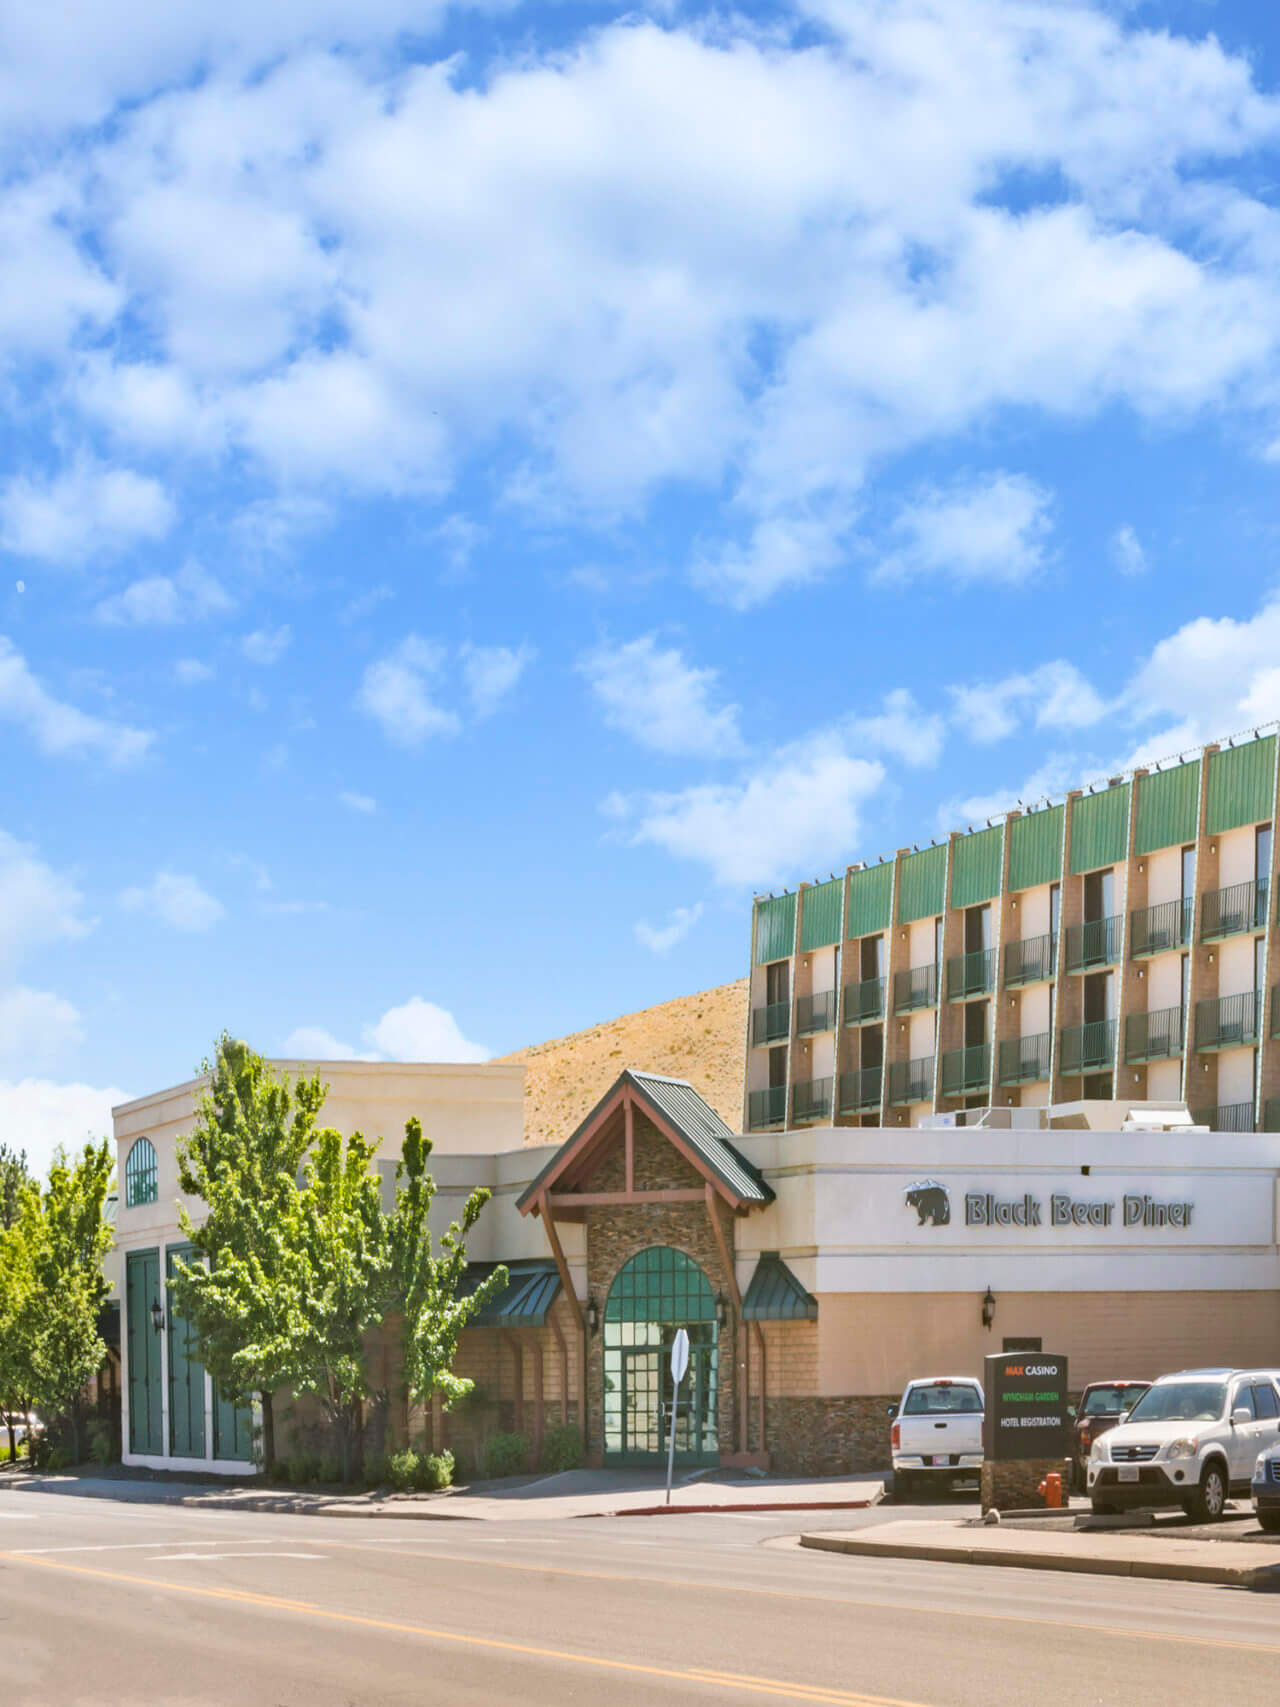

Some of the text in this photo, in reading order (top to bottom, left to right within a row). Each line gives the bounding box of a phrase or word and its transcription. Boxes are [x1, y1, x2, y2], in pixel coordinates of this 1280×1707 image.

[964, 1193, 1195, 1226] Black Bear Diner
[1005, 1366, 1058, 1376] MAX CASINO
[1001, 1416, 1061, 1428] HOTEL REGISTRATION
